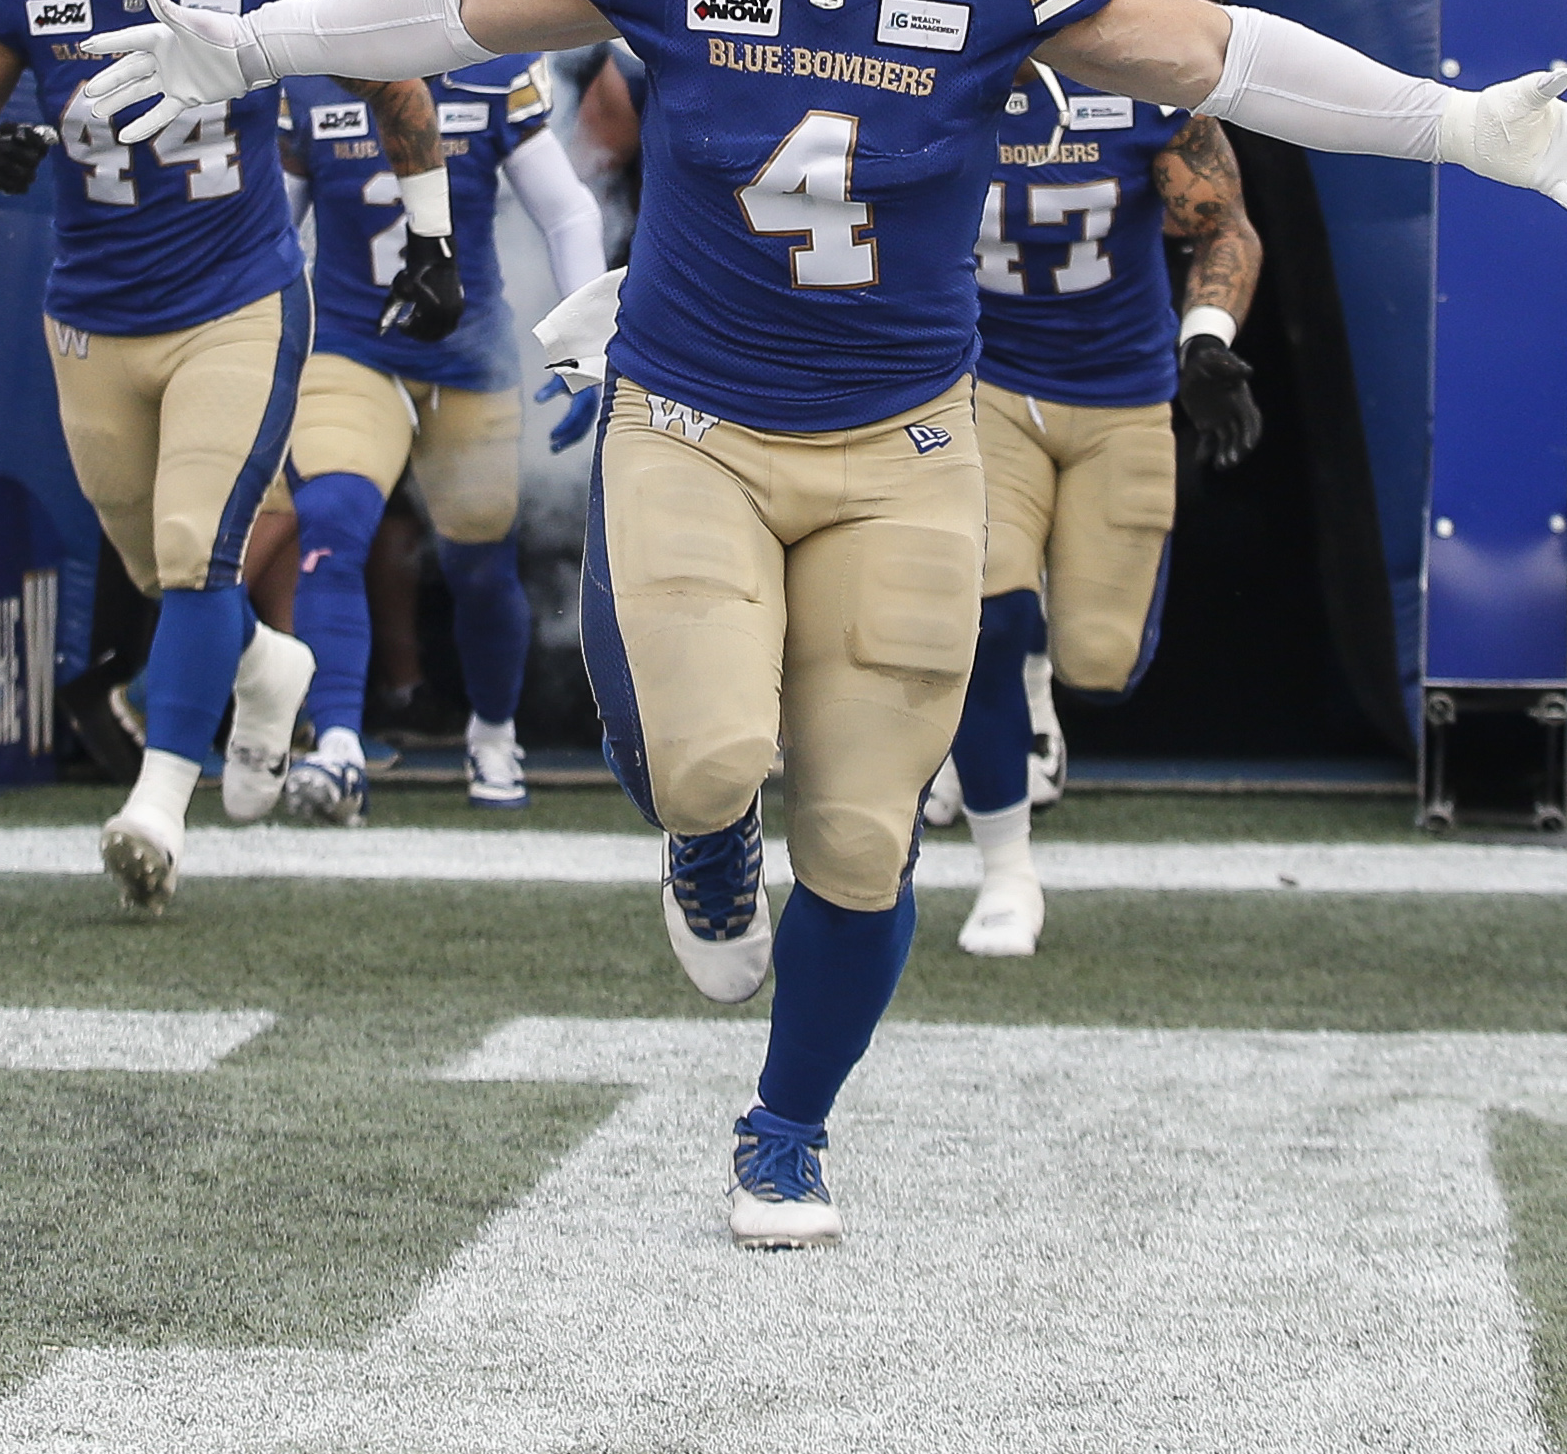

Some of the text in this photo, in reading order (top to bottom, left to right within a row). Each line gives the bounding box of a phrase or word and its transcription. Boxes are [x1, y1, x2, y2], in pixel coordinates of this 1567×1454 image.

[709, 3, 774, 24] NOW
[890, 12, 909, 28] IG
[910, 15, 941, 25] WEALTH
[910, 22, 960, 35] MANAGEMENT
[707, 38, 937, 97] BLUE BOMBERS
[60, 78, 244, 207] 44
[736, 108, 879, 290] 4
